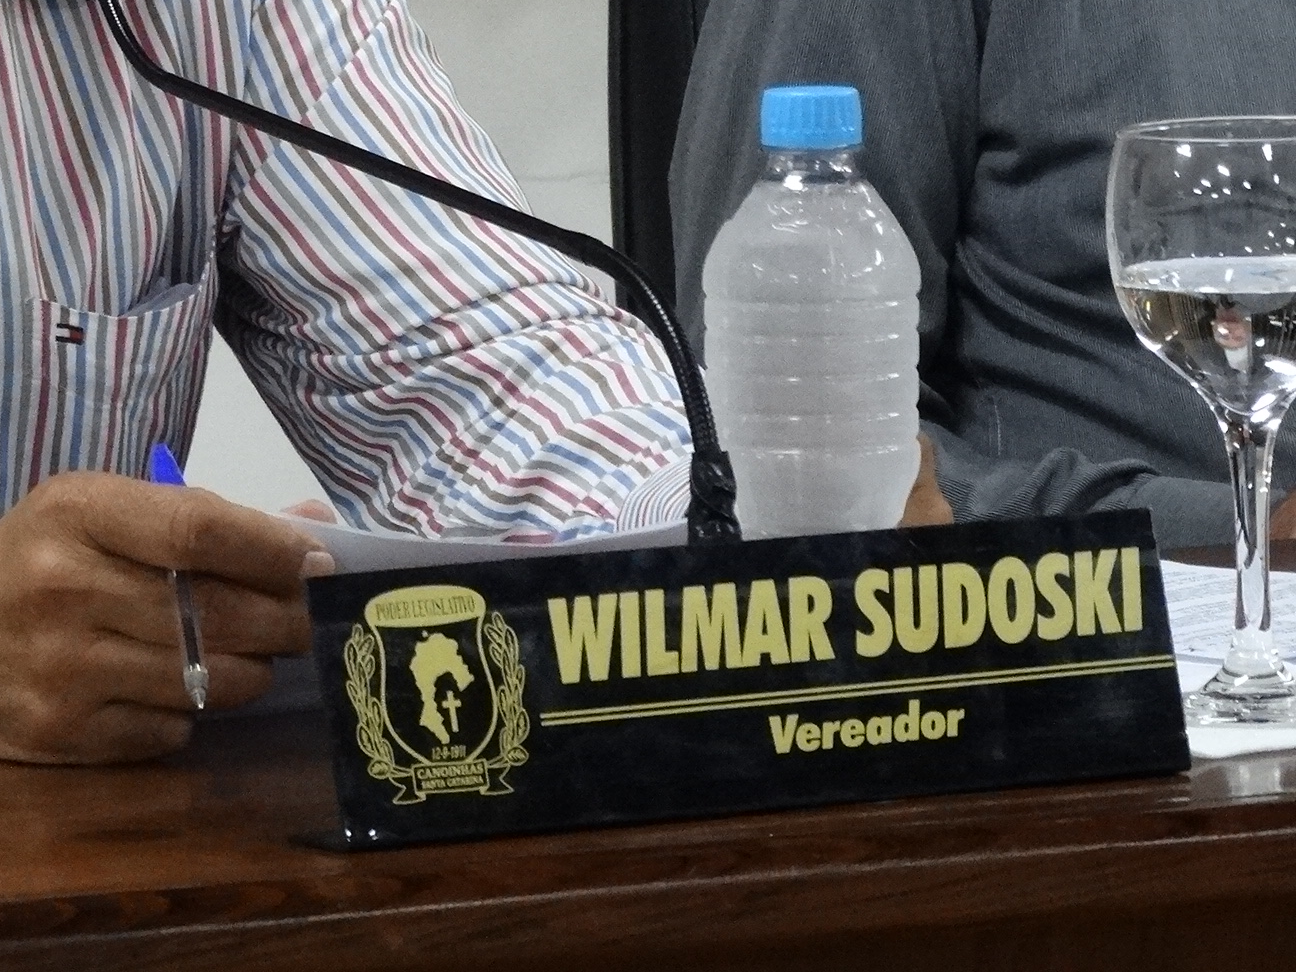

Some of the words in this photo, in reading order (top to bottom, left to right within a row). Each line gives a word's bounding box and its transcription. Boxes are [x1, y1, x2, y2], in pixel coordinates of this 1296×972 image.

[375, 601, 410, 620] PODER
[412, 595, 476, 618] LEGISLATIVO
[548, 576, 836, 684] WILMAR
[855, 547, 1143, 658] SUDOSKI
[769, 700, 965, 754] Vereador
[417, 763, 484, 779] CANOINHAS
[421, 778, 446, 789] SANTA
[446, 775, 484, 787] CATARINA
